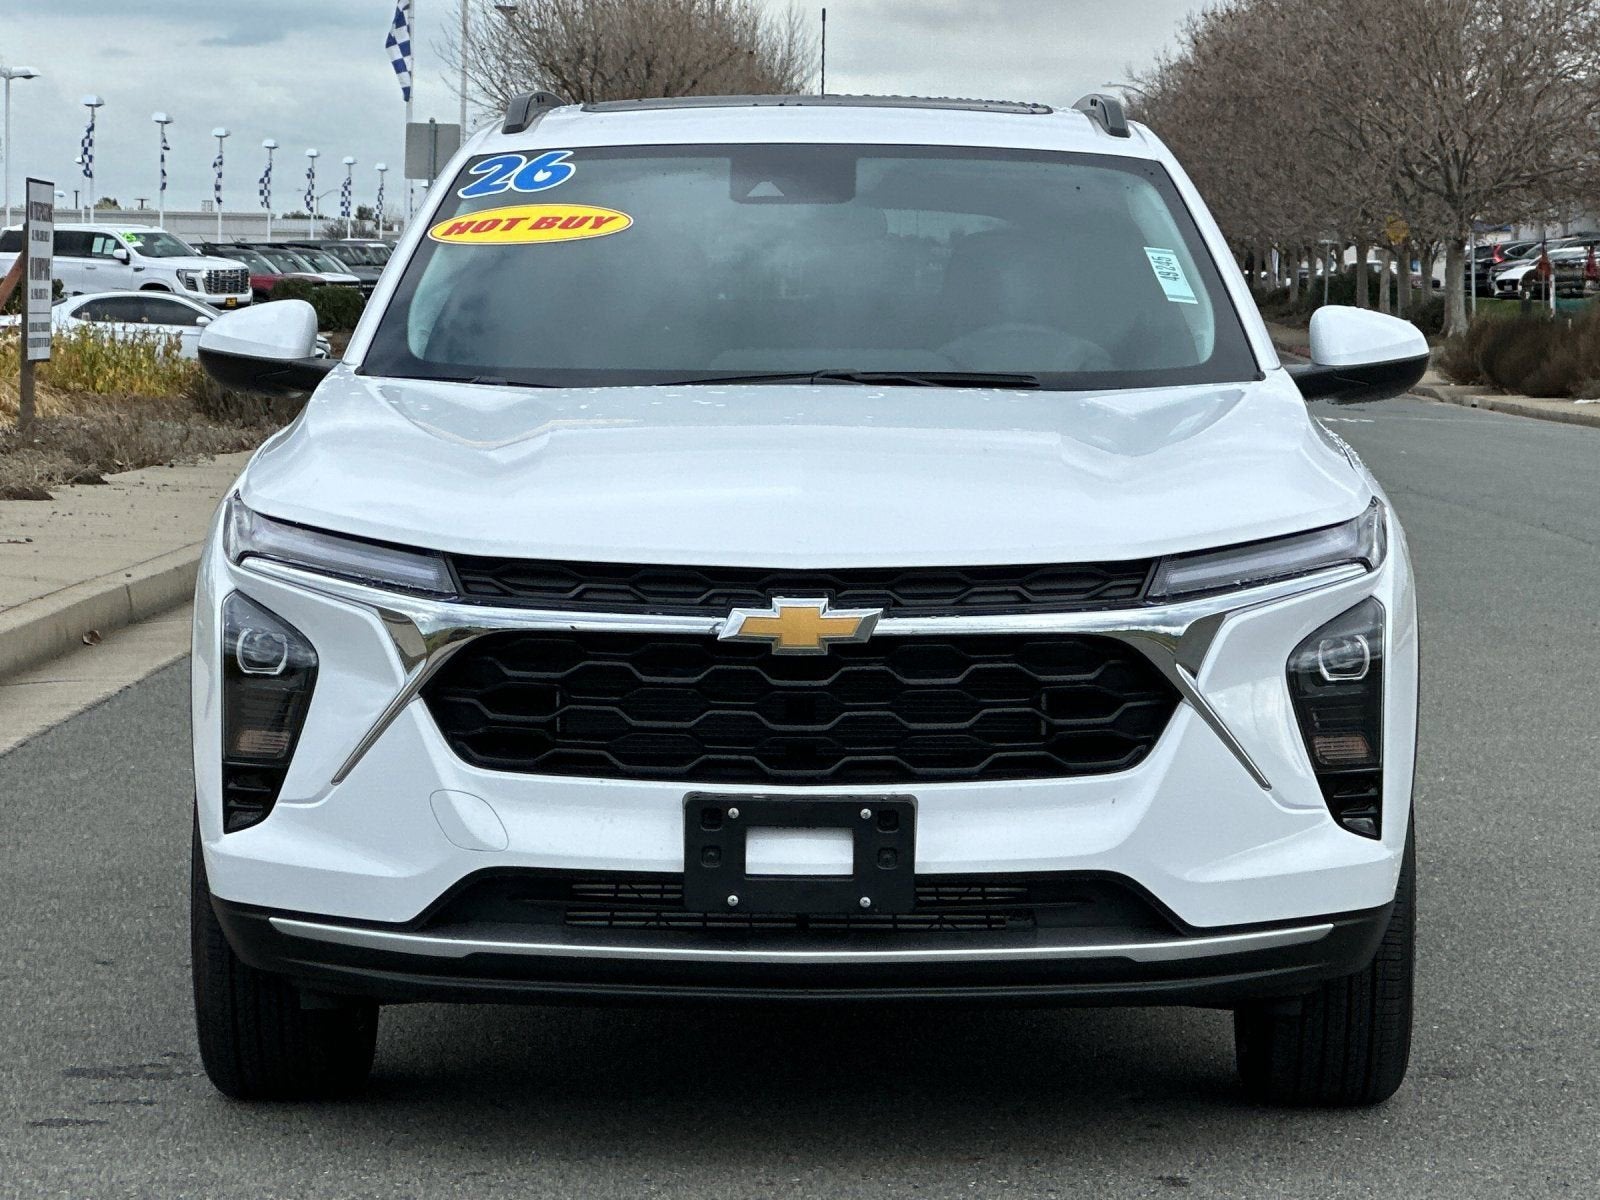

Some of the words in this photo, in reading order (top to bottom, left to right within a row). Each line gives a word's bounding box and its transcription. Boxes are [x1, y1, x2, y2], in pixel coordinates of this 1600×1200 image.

[457, 150, 576, 199] 26
[441, 216, 530, 236] HOT
[528, 215, 618, 231] BUY
